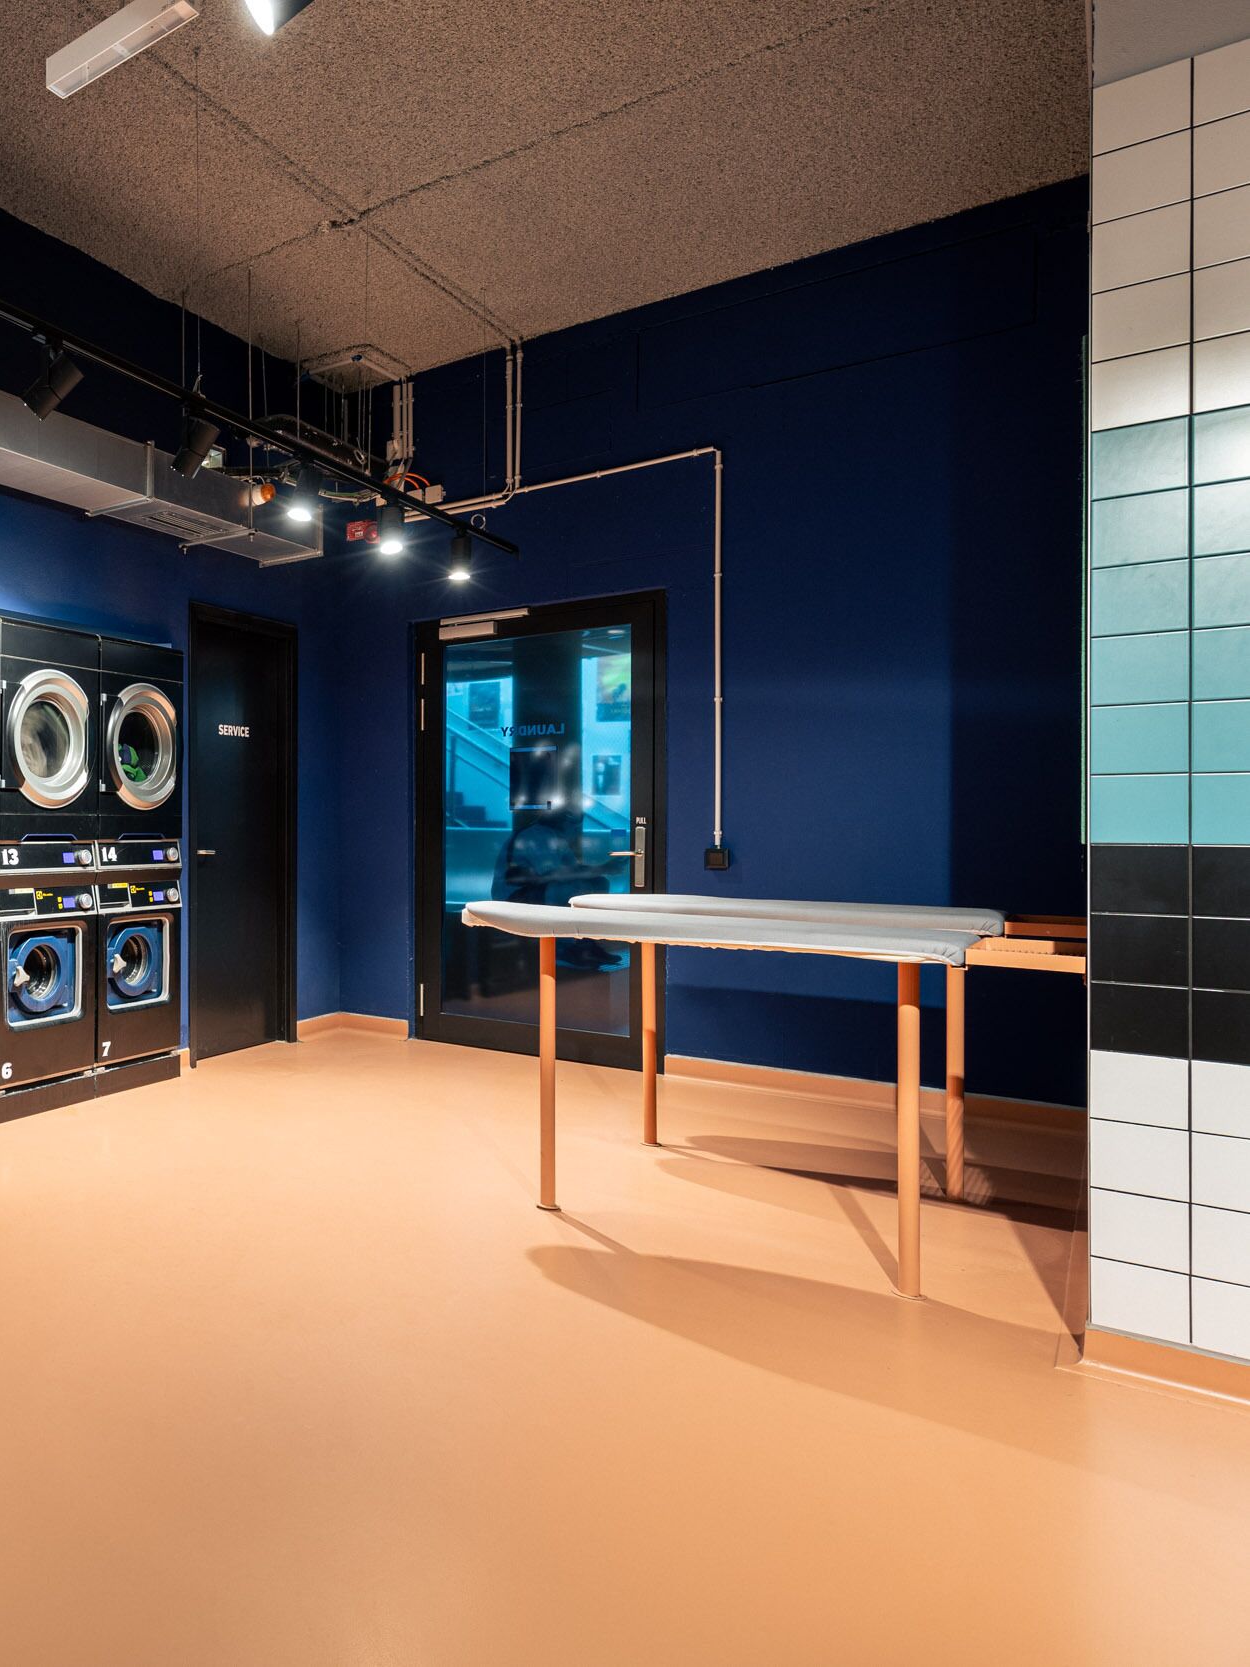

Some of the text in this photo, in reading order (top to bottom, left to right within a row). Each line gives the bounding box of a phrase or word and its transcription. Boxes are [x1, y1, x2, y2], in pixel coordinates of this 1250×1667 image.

[218, 724, 250, 738] SERVICE
[1, 848, 20, 866] 13
[101, 846, 118, 863] 14
[101, 1041, 112, 1057] 7
[1, 1062, 13, 1080] 6
